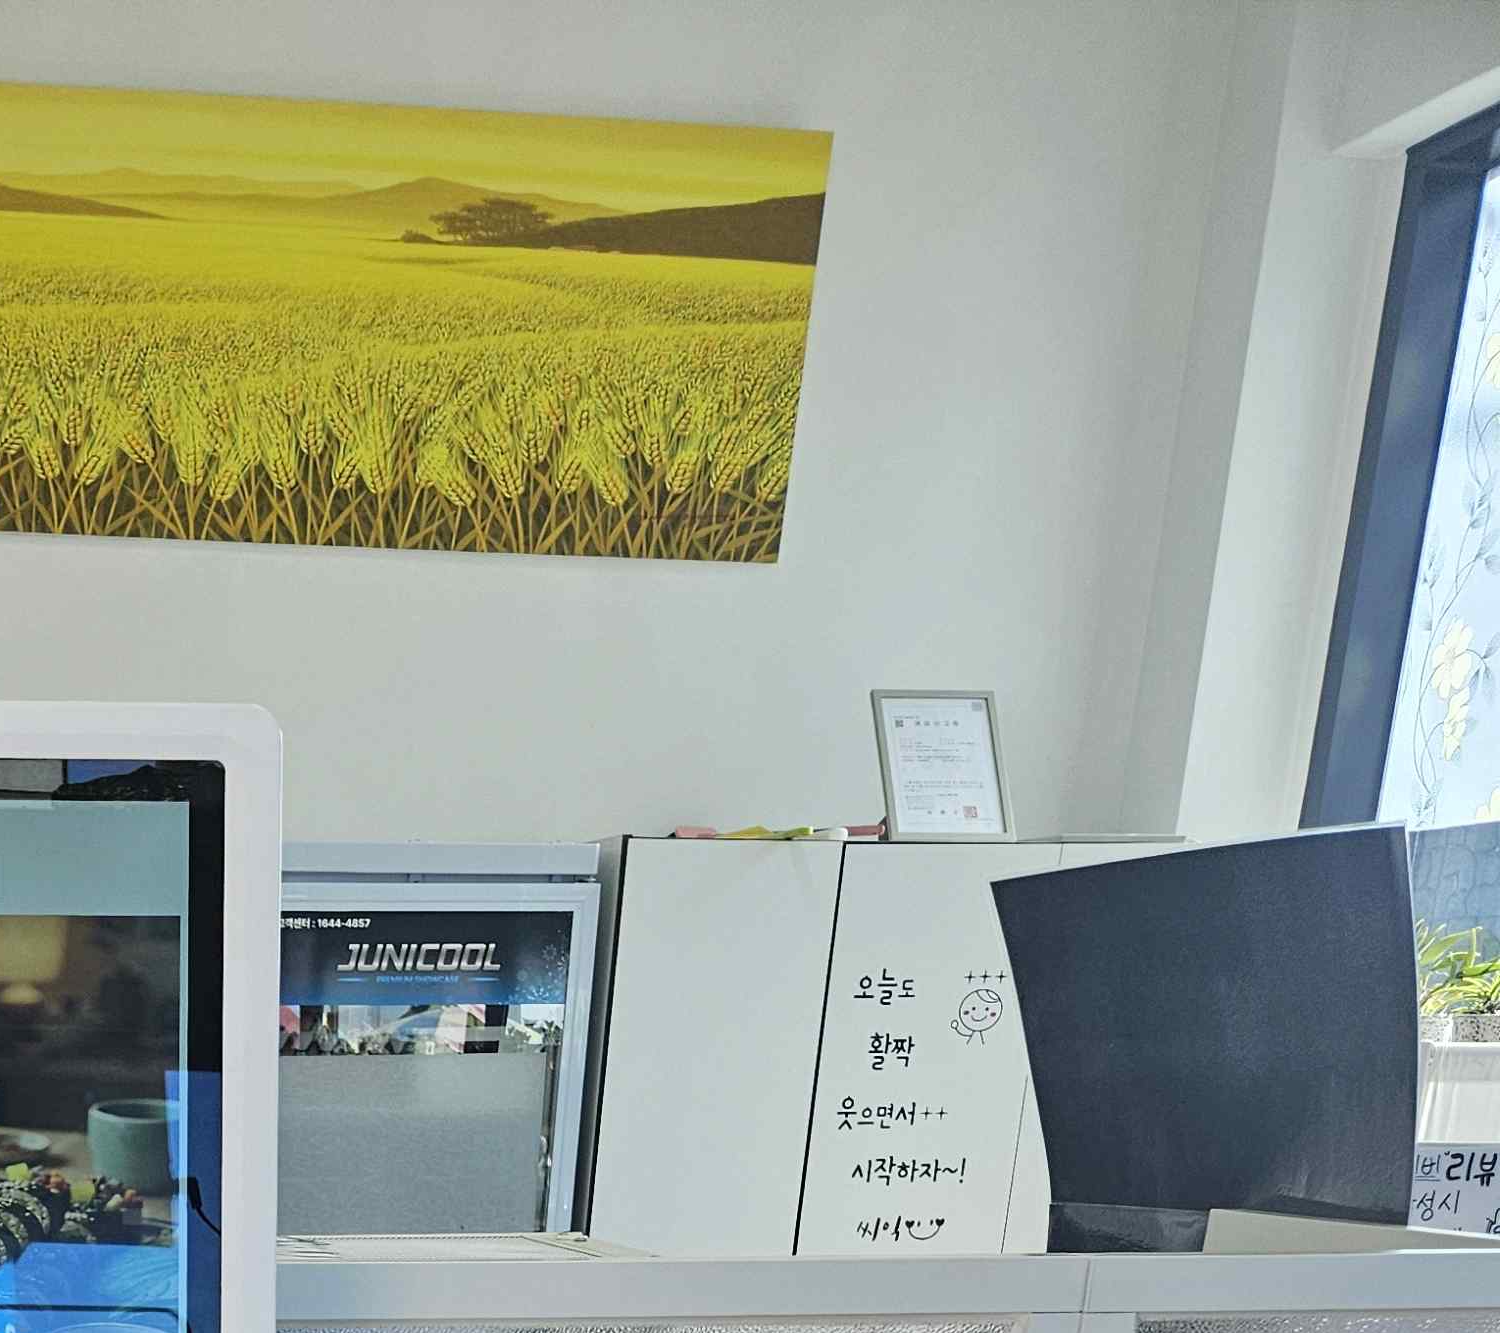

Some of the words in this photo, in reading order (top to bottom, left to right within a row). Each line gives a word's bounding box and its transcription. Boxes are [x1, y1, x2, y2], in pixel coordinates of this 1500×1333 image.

[317, 917, 372, 930] 1644-4857
[336, 943, 501, 972] JUNICOOL
[853, 968, 916, 1006] 오늘도
[868, 1032, 916, 1071] 활짝
[1445, 1151, 1498, 1187] 리뷰
[1412, 1189, 1461, 1222] 성시
